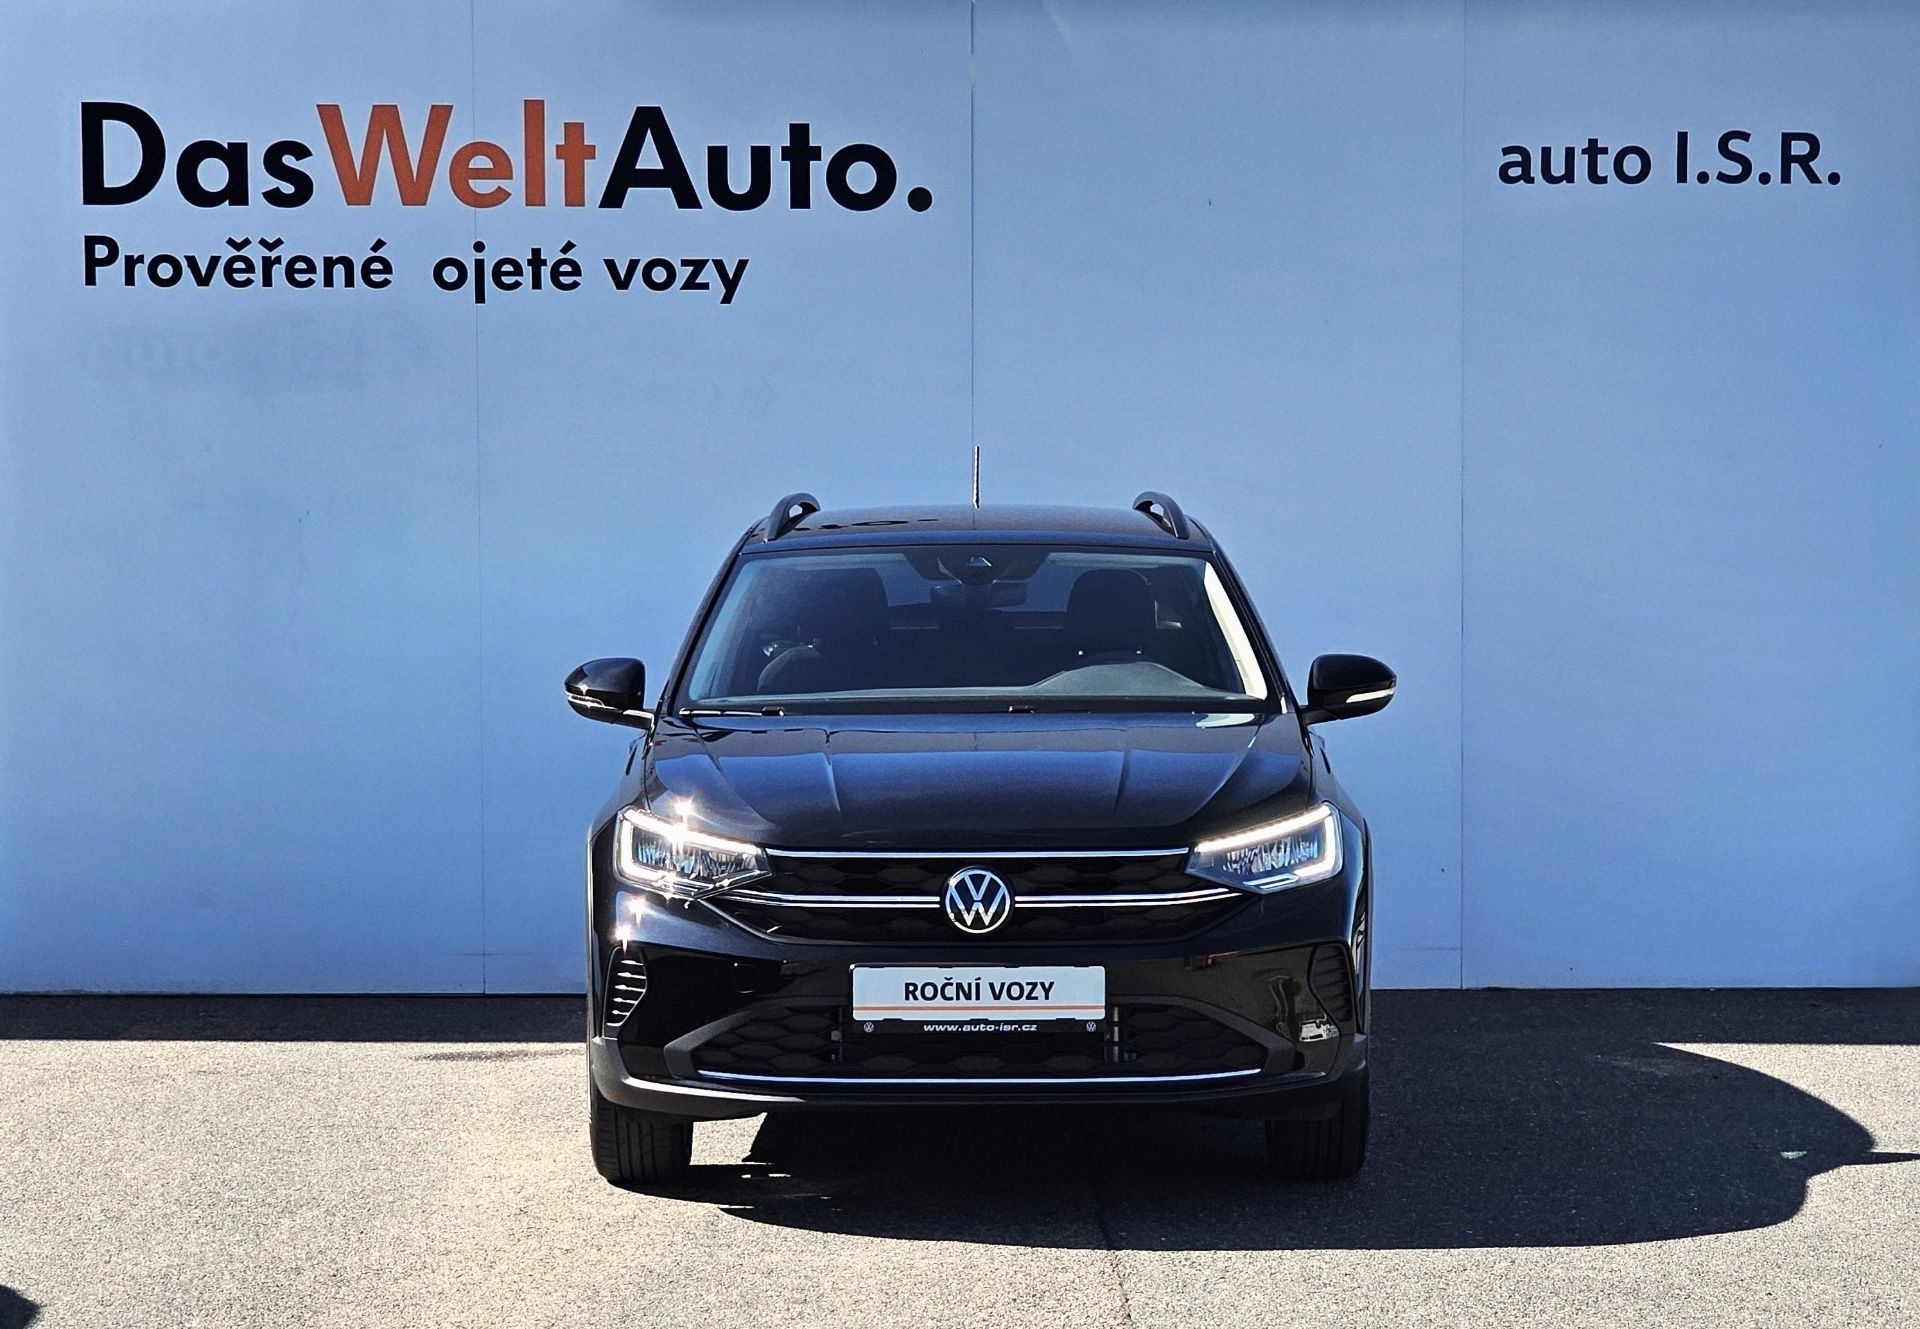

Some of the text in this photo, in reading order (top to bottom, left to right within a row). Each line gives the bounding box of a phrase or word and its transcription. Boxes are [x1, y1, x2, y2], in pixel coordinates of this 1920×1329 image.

[80, 98, 934, 213] DasWeltAuto.
[1498, 129, 1842, 186] auto I.S.R.
[83, 235, 750, 305] Prověřené ojeté vozy
[904, 976, 1055, 1001] ROČNÍ VOZY
[923, 1022, 1038, 1032] www.auto-isr.cz
